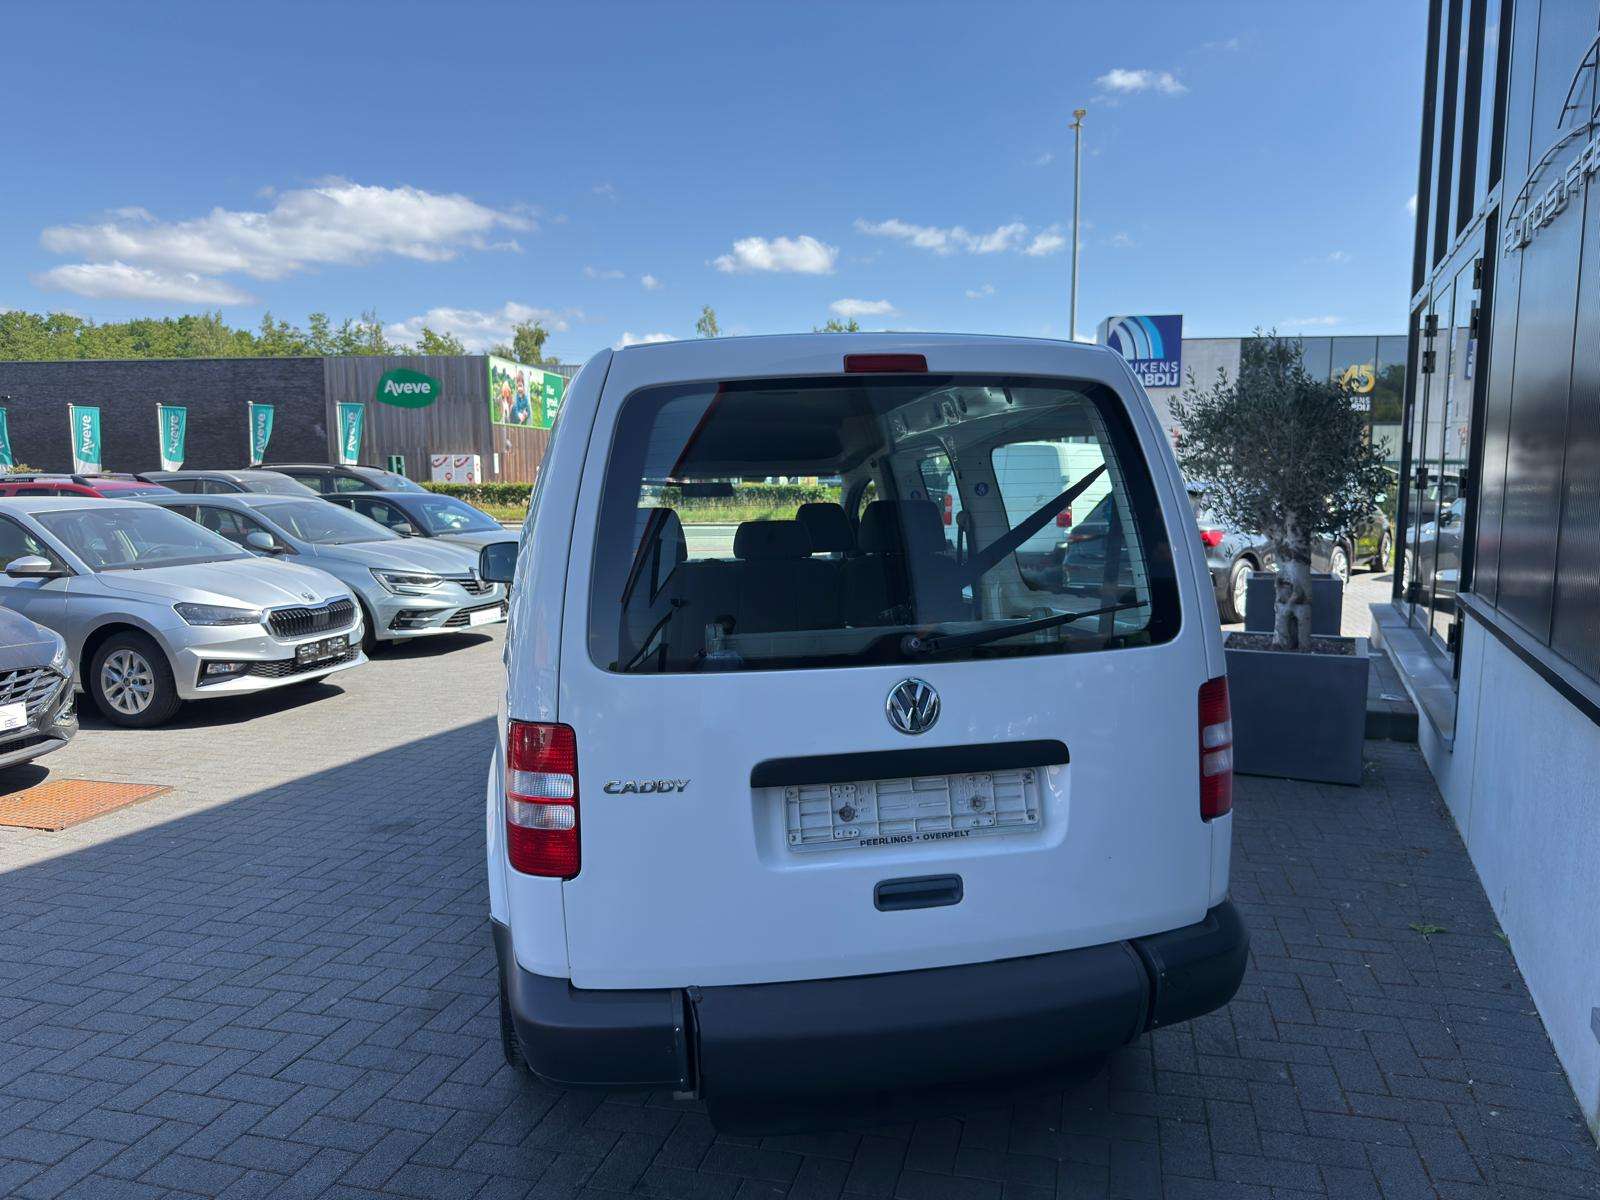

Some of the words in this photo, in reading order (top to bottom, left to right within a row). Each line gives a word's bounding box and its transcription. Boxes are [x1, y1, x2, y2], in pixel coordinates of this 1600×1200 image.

[384, 379, 432, 397] Aveve
[81, 415, 96, 455] Aveve
[168, 415, 180, 454] Aveve
[256, 413, 266, 453] Aveve
[603, 779, 692, 795] CADDY
[860, 835, 914, 846] PEERLINGS
[923, 830, 970, 841] OVERPELT
